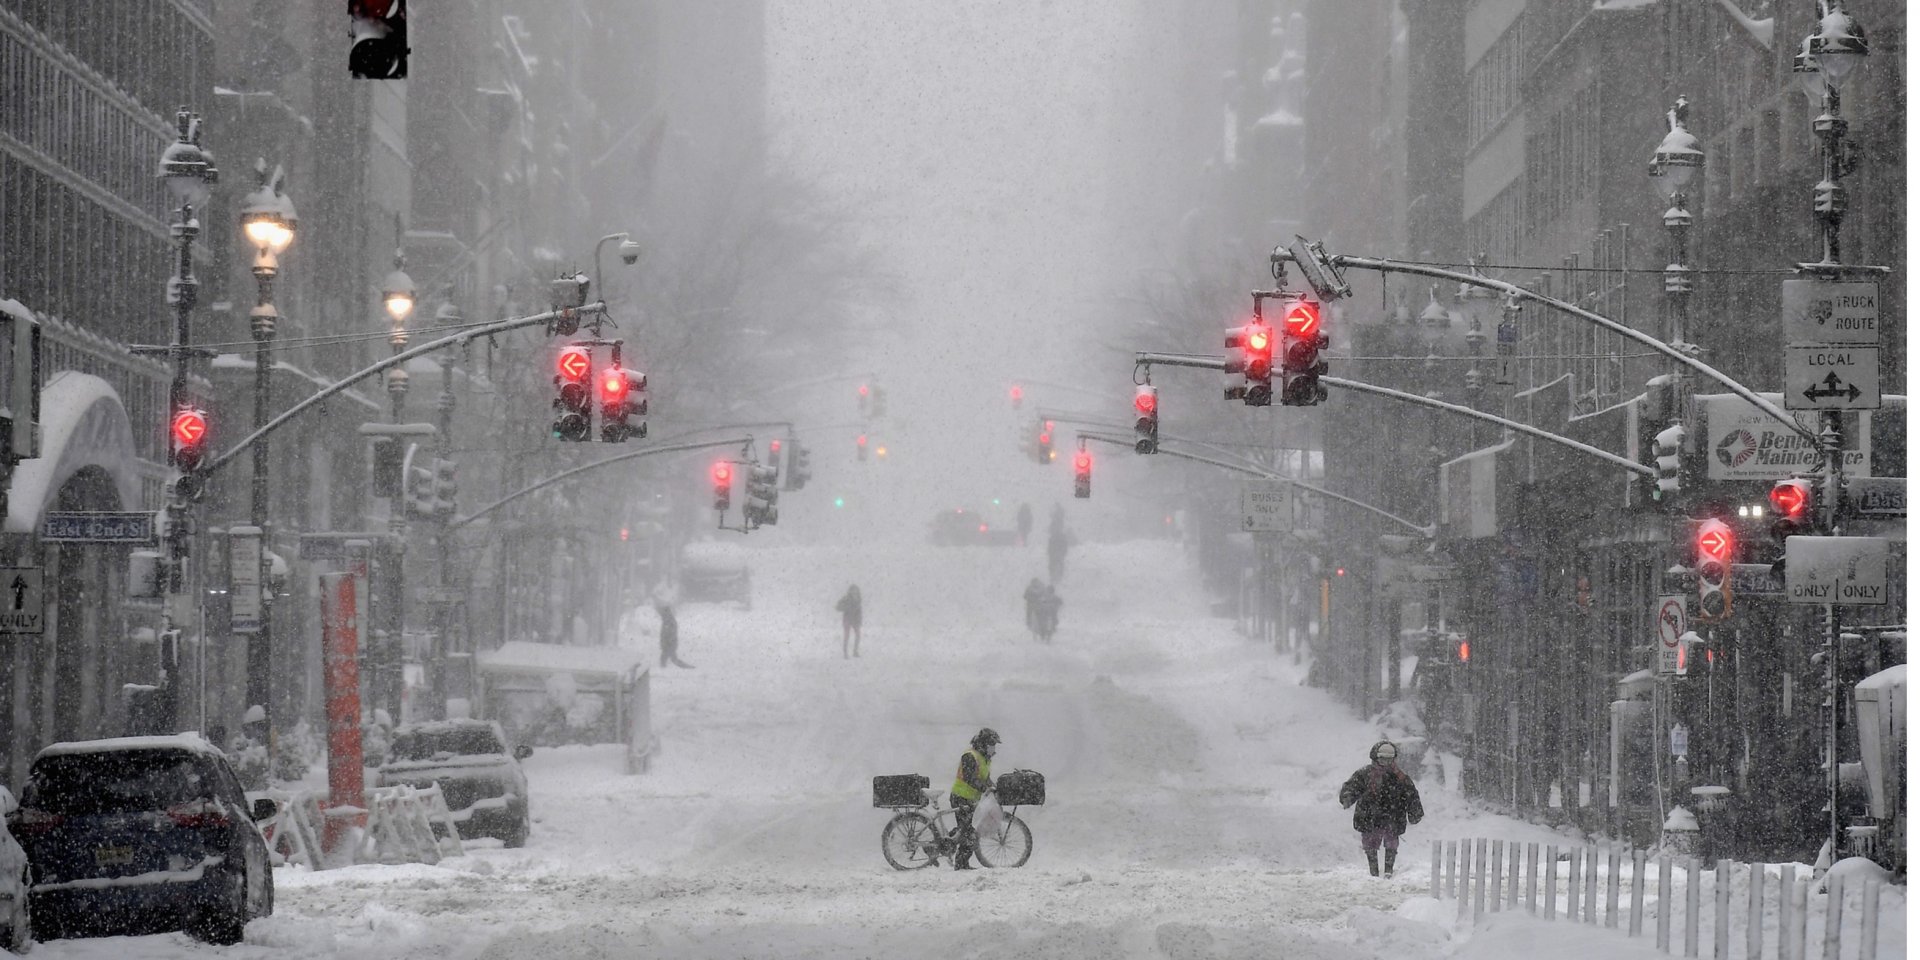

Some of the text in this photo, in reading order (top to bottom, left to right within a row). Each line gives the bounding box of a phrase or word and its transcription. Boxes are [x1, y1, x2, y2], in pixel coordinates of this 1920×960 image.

[1836, 295, 1875, 309] TRUCK
[1836, 317, 1875, 330] ROUTE
[1808, 353, 1855, 366] LOCAL
[1755, 449, 1864, 465] Maintence
[46, 522, 147, 537] East 42nd St
[1794, 583, 1831, 597] ONLY
[1843, 584, 1880, 598] ONLY
[0, 613, 38, 628] ONLY
